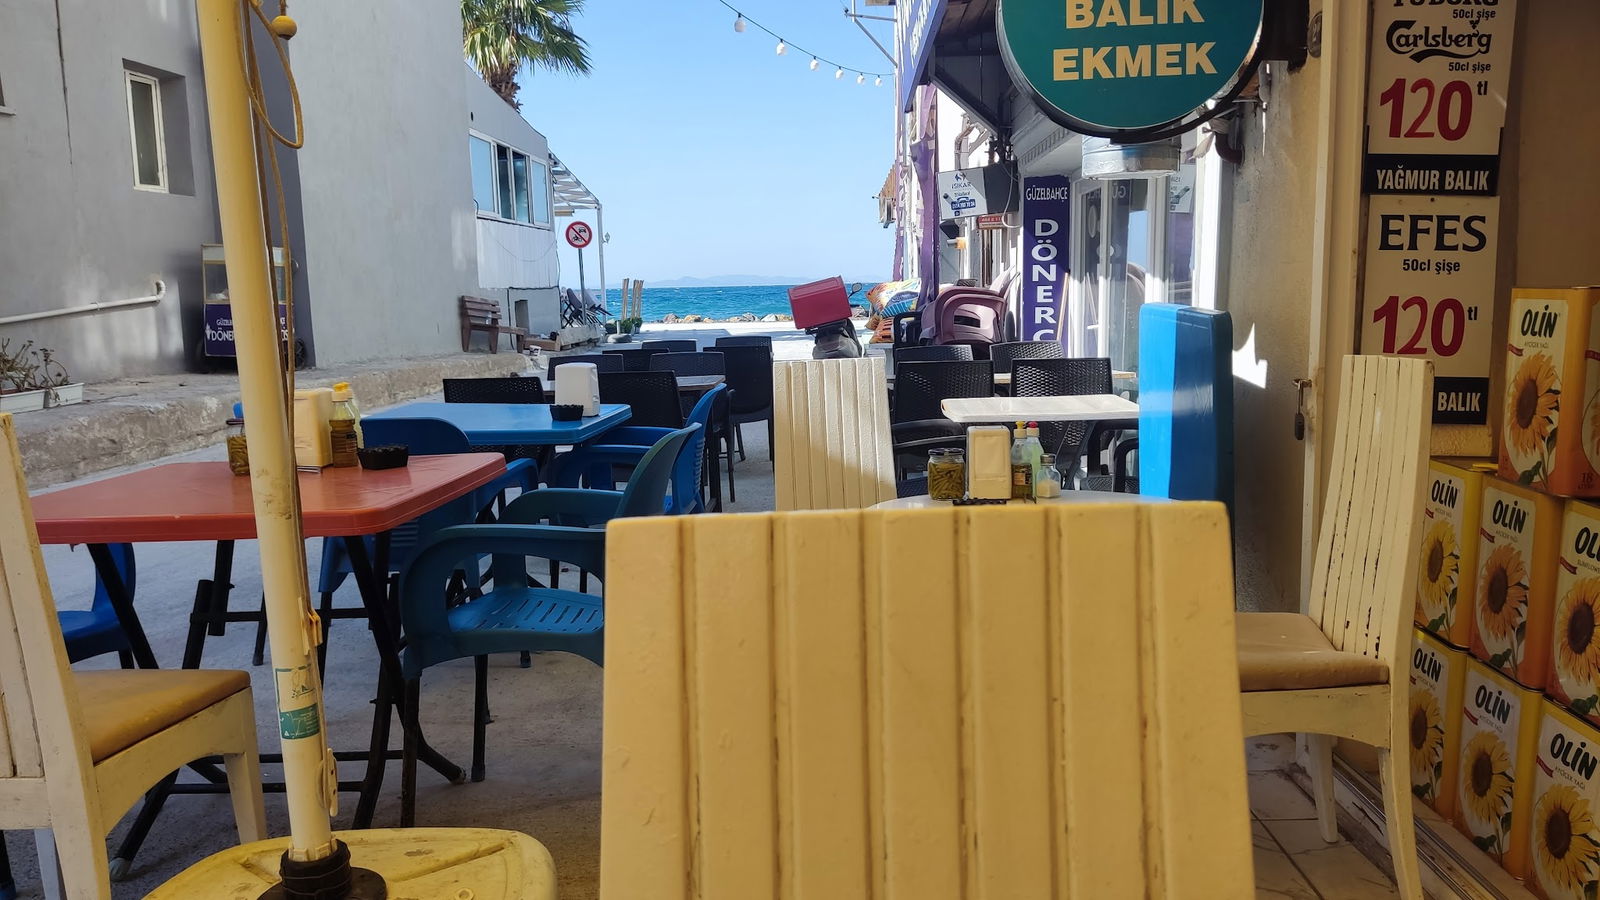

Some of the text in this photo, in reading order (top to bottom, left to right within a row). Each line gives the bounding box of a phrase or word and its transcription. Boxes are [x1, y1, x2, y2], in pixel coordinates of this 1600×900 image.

[1066, 0, 1205, 29] BALIK
[1453, 9, 1496, 20] 50cl şişe
[1386, 20, 1492, 55] Carlsberg
[1053, 42, 1218, 81] EKMEK
[1448, 62, 1491, 73] 50cl şişe
[1380, 78, 1488, 141] 120 tl
[1376, 165, 1489, 190] YAĞMUR BALIK
[1026, 185, 1068, 203] GÜZELBAHÇE
[1378, 214, 1487, 252] EFES
[1402, 259, 1460, 275] 50cl şişe
[1373, 296, 1478, 357] 120 tl
[1437, 392, 1481, 411] BALIK
[1575, 527, 1600, 561] OL
